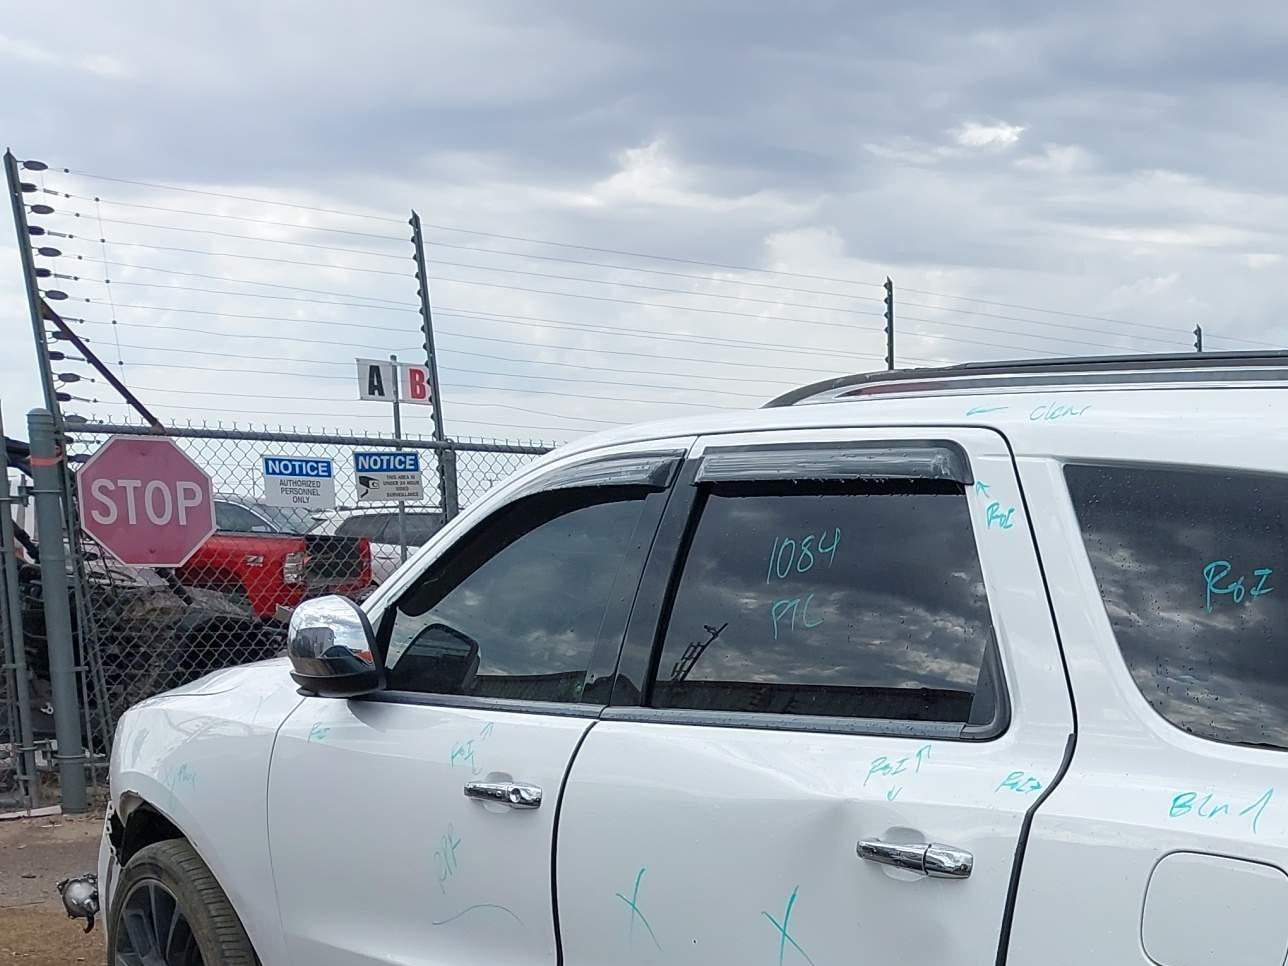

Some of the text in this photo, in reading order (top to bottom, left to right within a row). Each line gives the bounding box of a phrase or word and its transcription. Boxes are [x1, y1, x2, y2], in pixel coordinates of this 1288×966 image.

[367, 364, 385, 397] A
[408, 367, 427, 400] B
[267, 459, 329, 477] NOTICE
[358, 455, 416, 470] NOTICE
[279, 479, 321, 489] AUTHORIZED
[280, 487, 321, 497] PERSONNEL
[90, 478, 203, 527] STOP
[292, 495, 310, 504] ONLY
[766, 527, 841, 585] 1084
